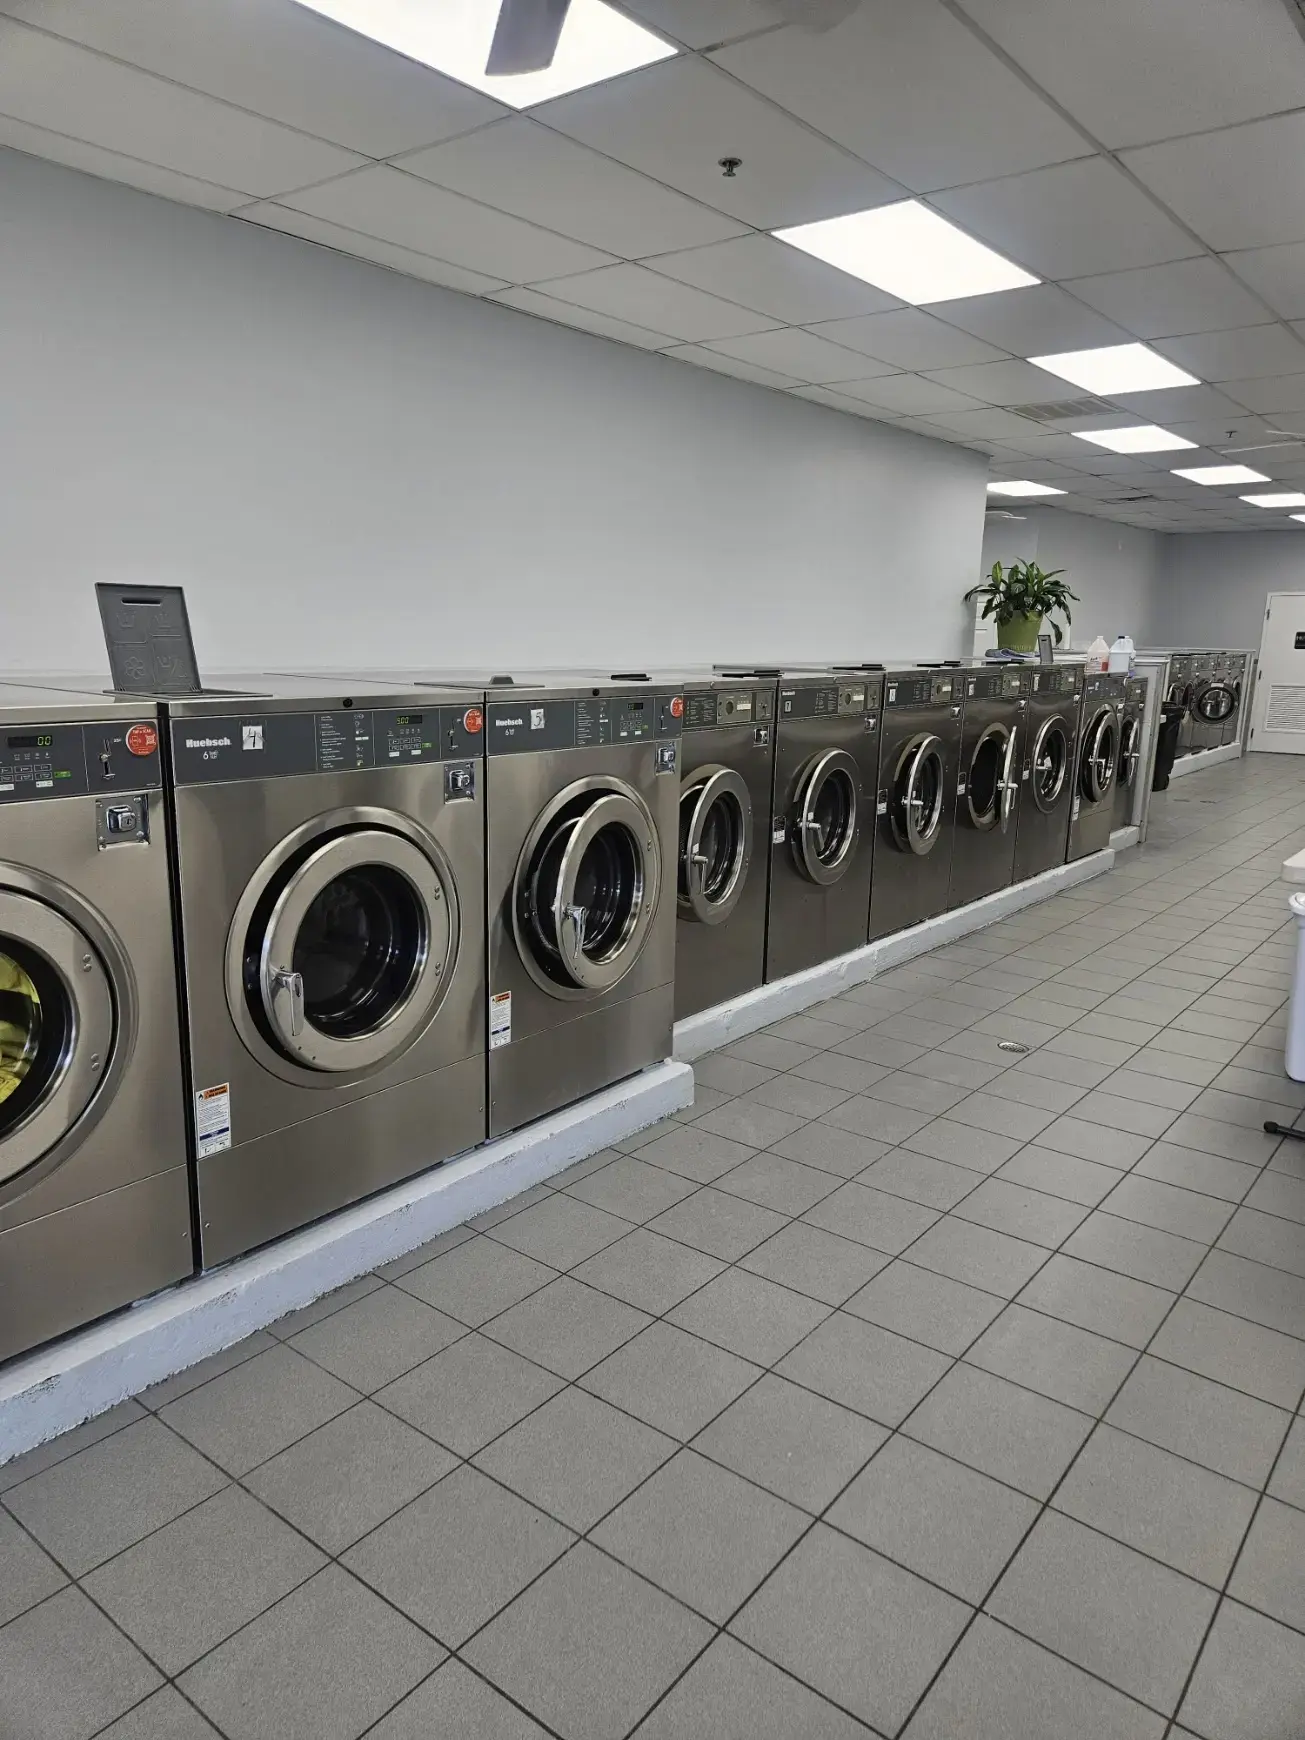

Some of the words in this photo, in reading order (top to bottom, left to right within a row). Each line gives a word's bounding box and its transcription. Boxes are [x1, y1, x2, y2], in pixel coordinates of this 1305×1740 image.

[534, 711, 543, 727] 5
[185, 737, 231, 749] Huebsch
[248, 728, 258, 748] 4
